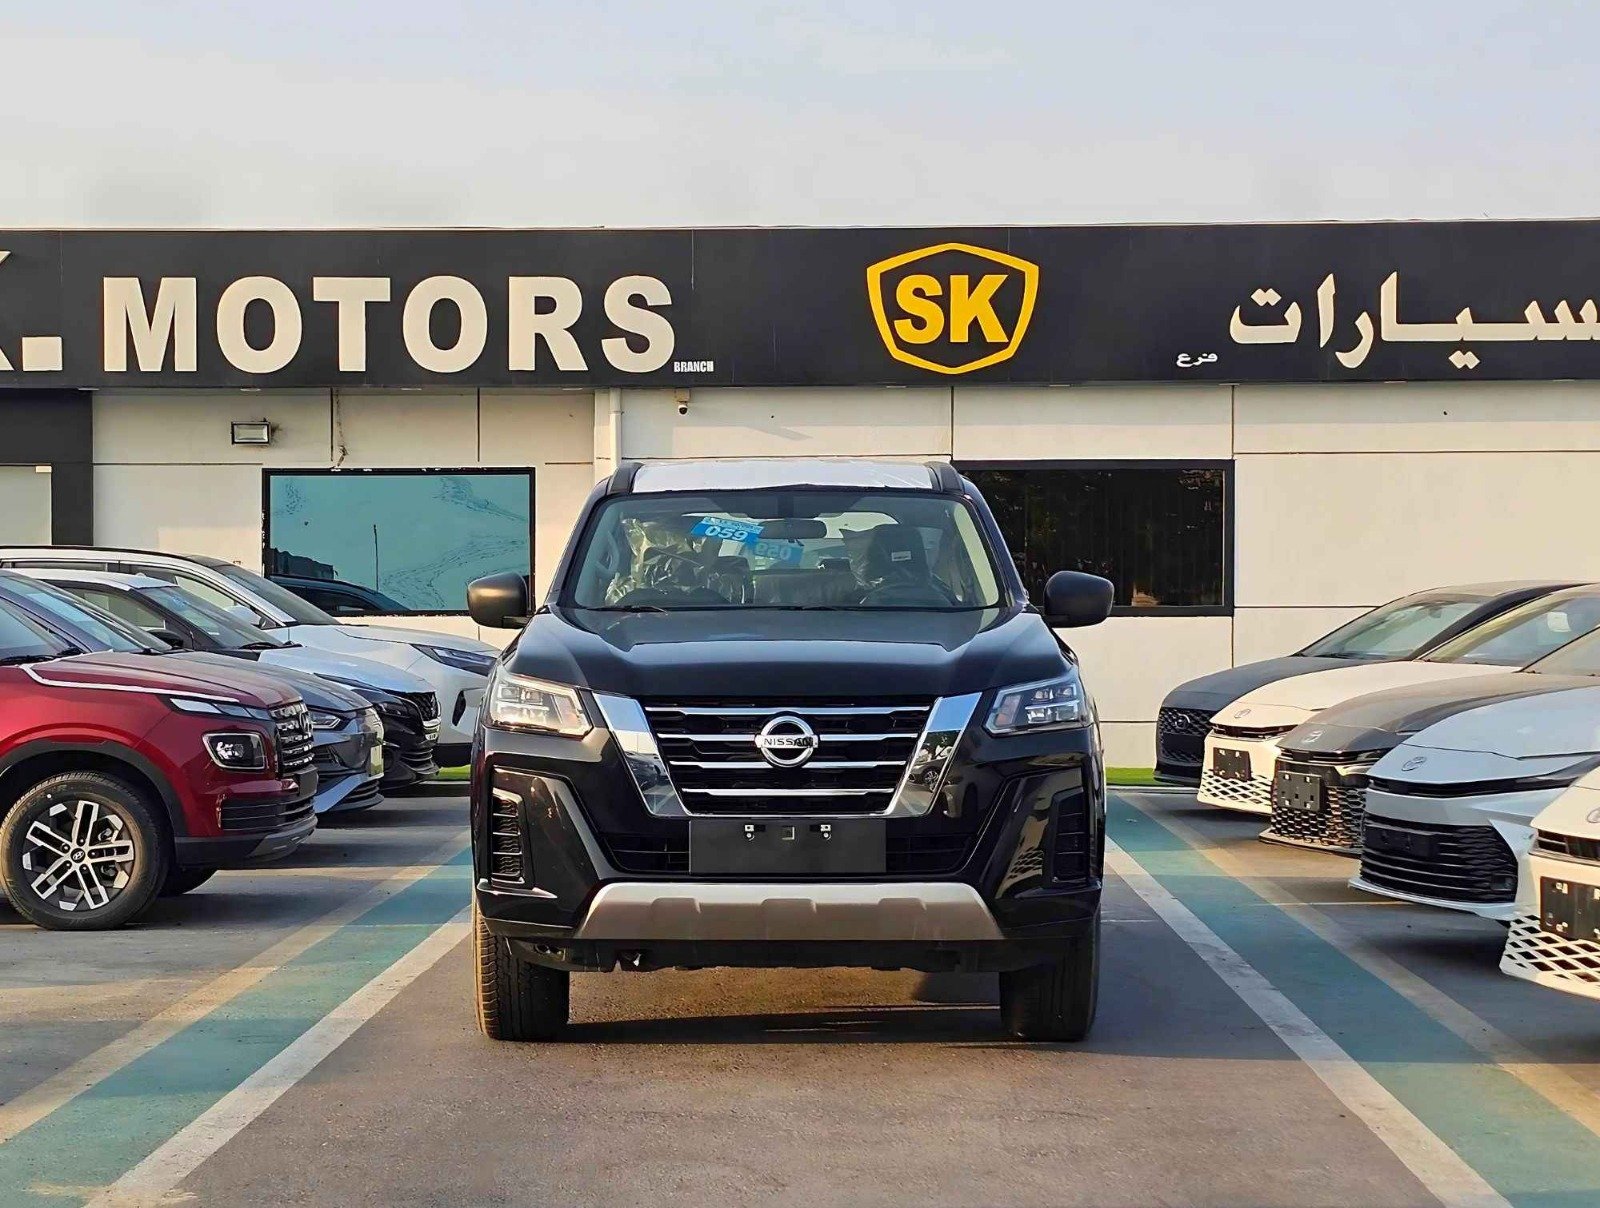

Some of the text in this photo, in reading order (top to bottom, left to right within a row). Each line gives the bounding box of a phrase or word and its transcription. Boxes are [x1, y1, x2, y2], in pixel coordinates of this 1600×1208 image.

[893, 274, 1010, 345] SK
[103, 276, 675, 374] MOTORS
[673, 360, 714, 373] BRANCH
[1176, 353, 1218, 368] فرع
[705, 525, 749, 541] 059
